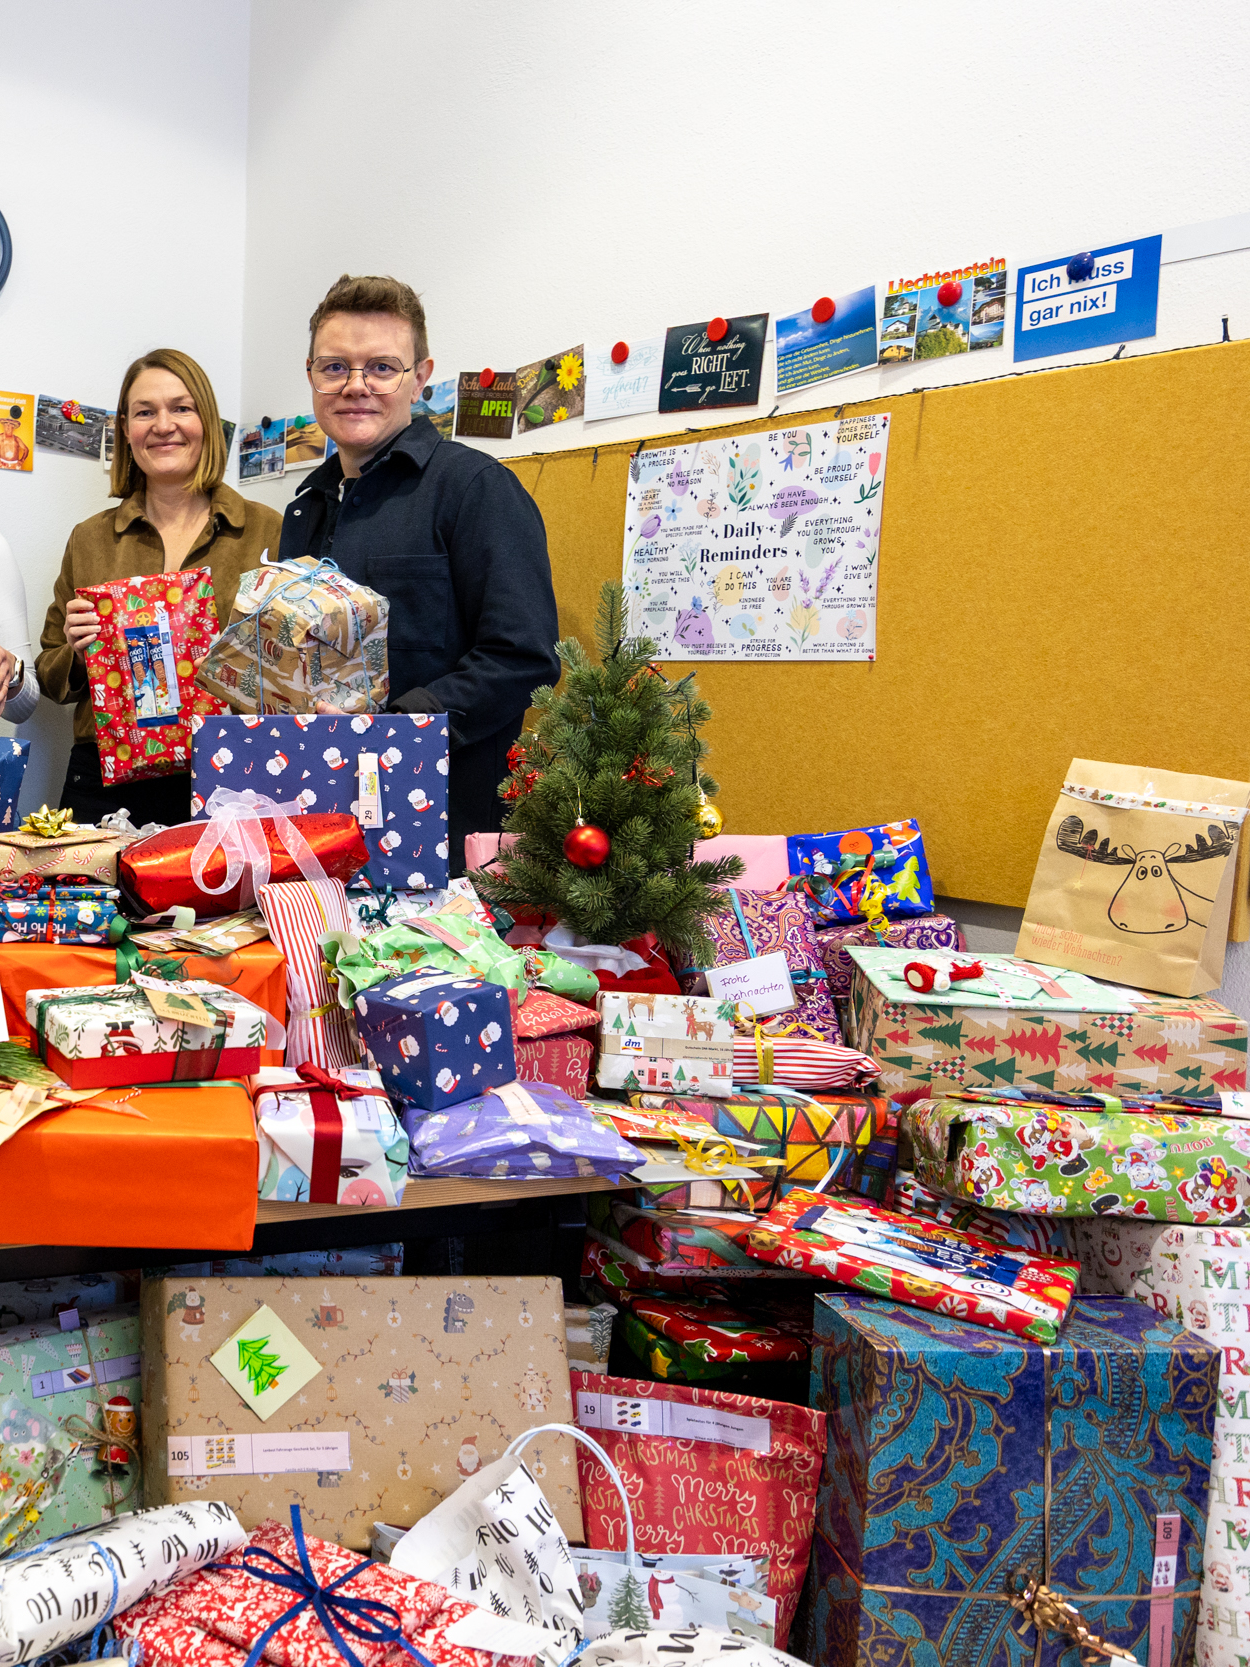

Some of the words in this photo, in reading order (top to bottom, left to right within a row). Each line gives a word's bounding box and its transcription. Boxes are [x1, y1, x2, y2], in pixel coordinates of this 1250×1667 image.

[888, 256, 1006, 294] Liechtenstein
[1031, 272, 1060, 293] Ich
[1029, 302, 1063, 327] gar
[1069, 291, 1107, 314] nix!
[682, 332, 711, 355] When
[716, 334, 747, 361] nothing
[665, 370, 688, 389] goes
[691, 354, 730, 375] RIGHT
[602, 376, 648, 403] gefreut?
[699, 386, 716, 403] go
[718, 369, 751, 393] LEFT.
[480, 400, 513, 417] APFEL
[840, 416, 876, 426] HAPPINESS
[838, 426, 858, 435] COMES
[859, 423, 878, 432] FROM
[782, 430, 797, 440] YOU
[836, 430, 880, 443] YOURSELF
[640, 451, 666, 460] GROWTH
[648, 458, 675, 468] PROCESS
[827, 464, 852, 473] PROUD
[676, 470, 690, 478] NICE
[820, 473, 858, 484] YOURSELF
[677, 478, 702, 487] REASON
[787, 490, 807, 498] HAVE
[748, 502, 778, 511] ALWAYS
[781, 500, 798, 508] BEEN
[801, 497, 829, 506] ENOUGH
[805, 516, 853, 527] EVERYTHING
[723, 522, 763, 541] Daily
[826, 526, 861, 535] THROUGH
[813, 537, 842, 545] GROWS
[634, 547, 669, 557] HEALTHY
[700, 545, 788, 563] Reminders
[736, 571, 754, 579] CAN
[738, 582, 757, 590] THIS
[768, 583, 791, 592] LOVED
[741, 644, 782, 652] PROGRESS
[365, 810, 372, 820] 29
[1059, 930, 1084, 944] schon
[1032, 936, 1062, 951] wieder
[1063, 941, 1123, 967] Weihnachten?
[720, 975, 750, 987] Frohe
[625, 1039, 641, 1048] dm
[1170, 1137, 1215, 1154] ROFU
[40, 1381, 45, 1390] 1
[584, 1405, 596, 1415] 19
[171, 1451, 190, 1461] 105
[671, 1474, 756, 1516] Merry
[1163, 1520, 1172, 1540] 109
